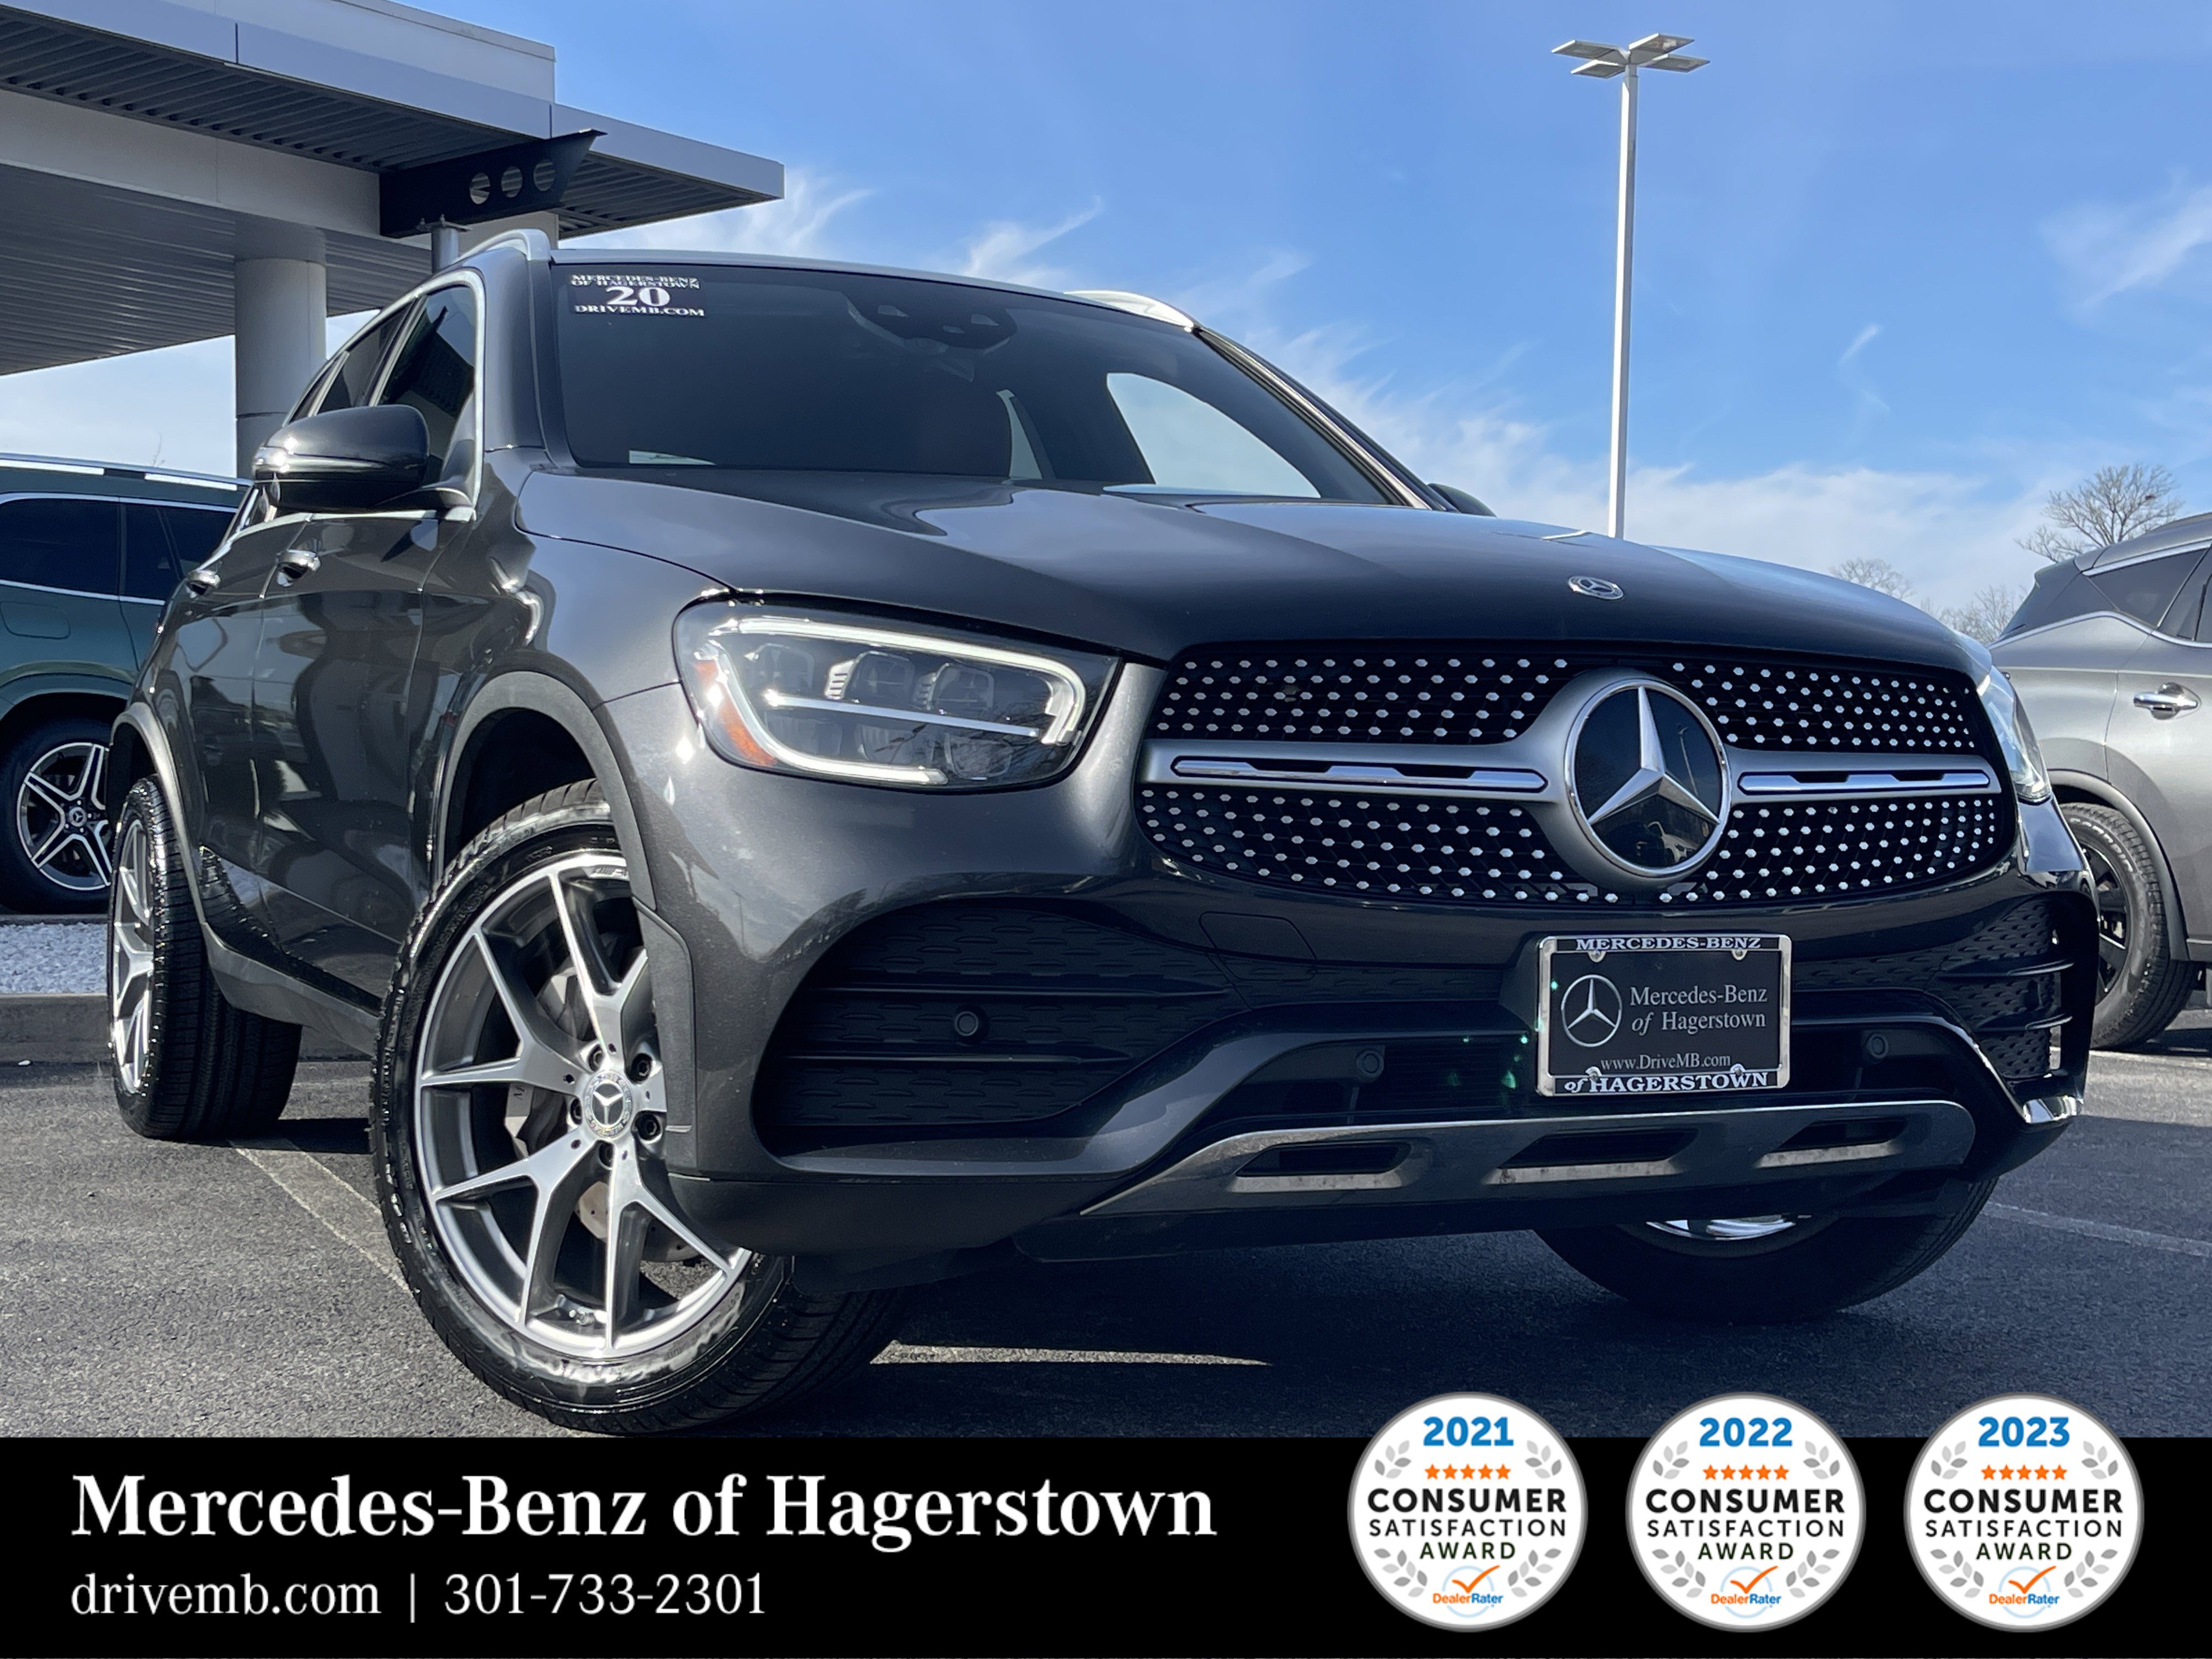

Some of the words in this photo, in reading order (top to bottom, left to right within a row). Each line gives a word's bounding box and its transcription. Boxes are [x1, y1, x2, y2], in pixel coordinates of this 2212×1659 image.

[597, 280, 700, 289] HAGERSTOWN
[606, 286, 670, 307] 20
[575, 304, 704, 317] DRIVEMB.COM
[1576, 937, 1761, 951] MERCEDES-BENZ
[1630, 985, 1768, 1006] Mercedes-Benz
[1632, 1012, 1653, 1036] of
[1662, 1012, 1767, 1035] Hagerstown
[1600, 1053, 1731, 1070] www.DriveMB.com
[1564, 1077, 1585, 1093] of
[1589, 1072, 1768, 1093] HAGERSTOWN
